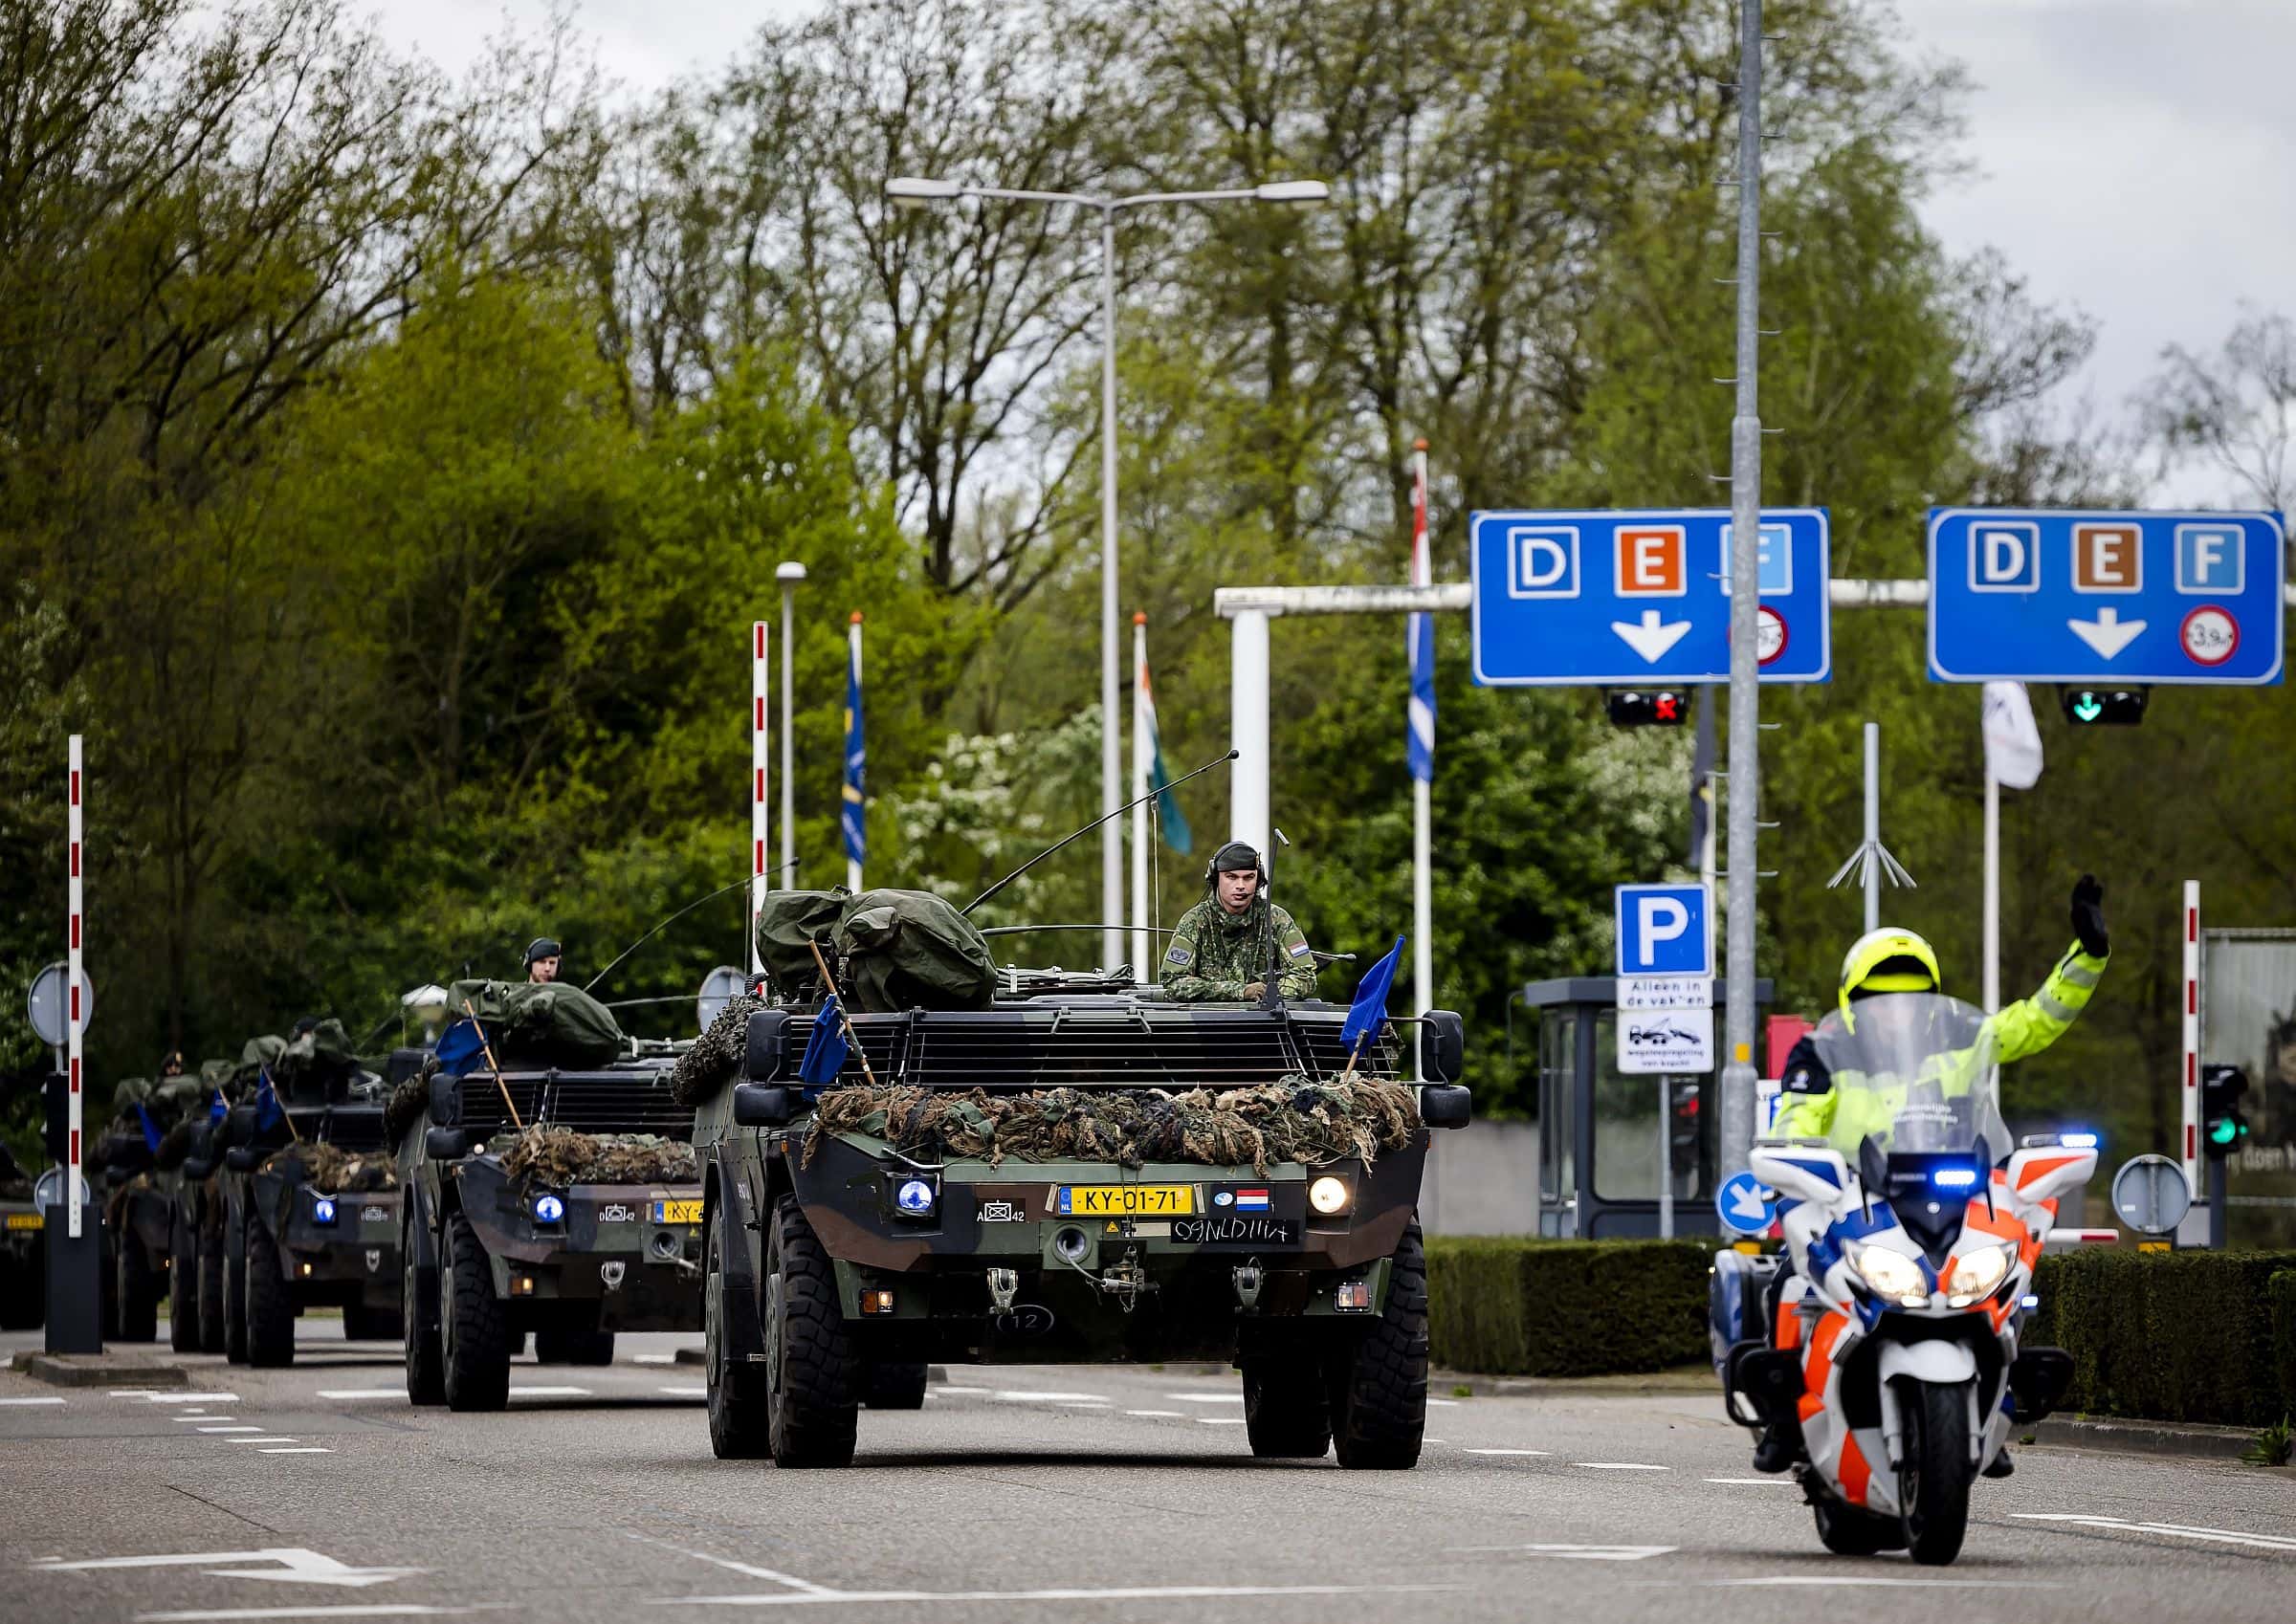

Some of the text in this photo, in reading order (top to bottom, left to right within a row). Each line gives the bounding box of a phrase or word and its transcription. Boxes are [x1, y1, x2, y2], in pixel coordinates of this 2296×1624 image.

[1521, 538, 1666, 586] D E
[1984, 533, 2225, 584] D E F
[1638, 897, 1689, 966] P
[1085, 1191, 1177, 1211] KY-01-71
[976, 1211, 984, 1222] A
[1011, 1211, 1025, 1222] 42
[1011, 1314, 1038, 1328] 12
